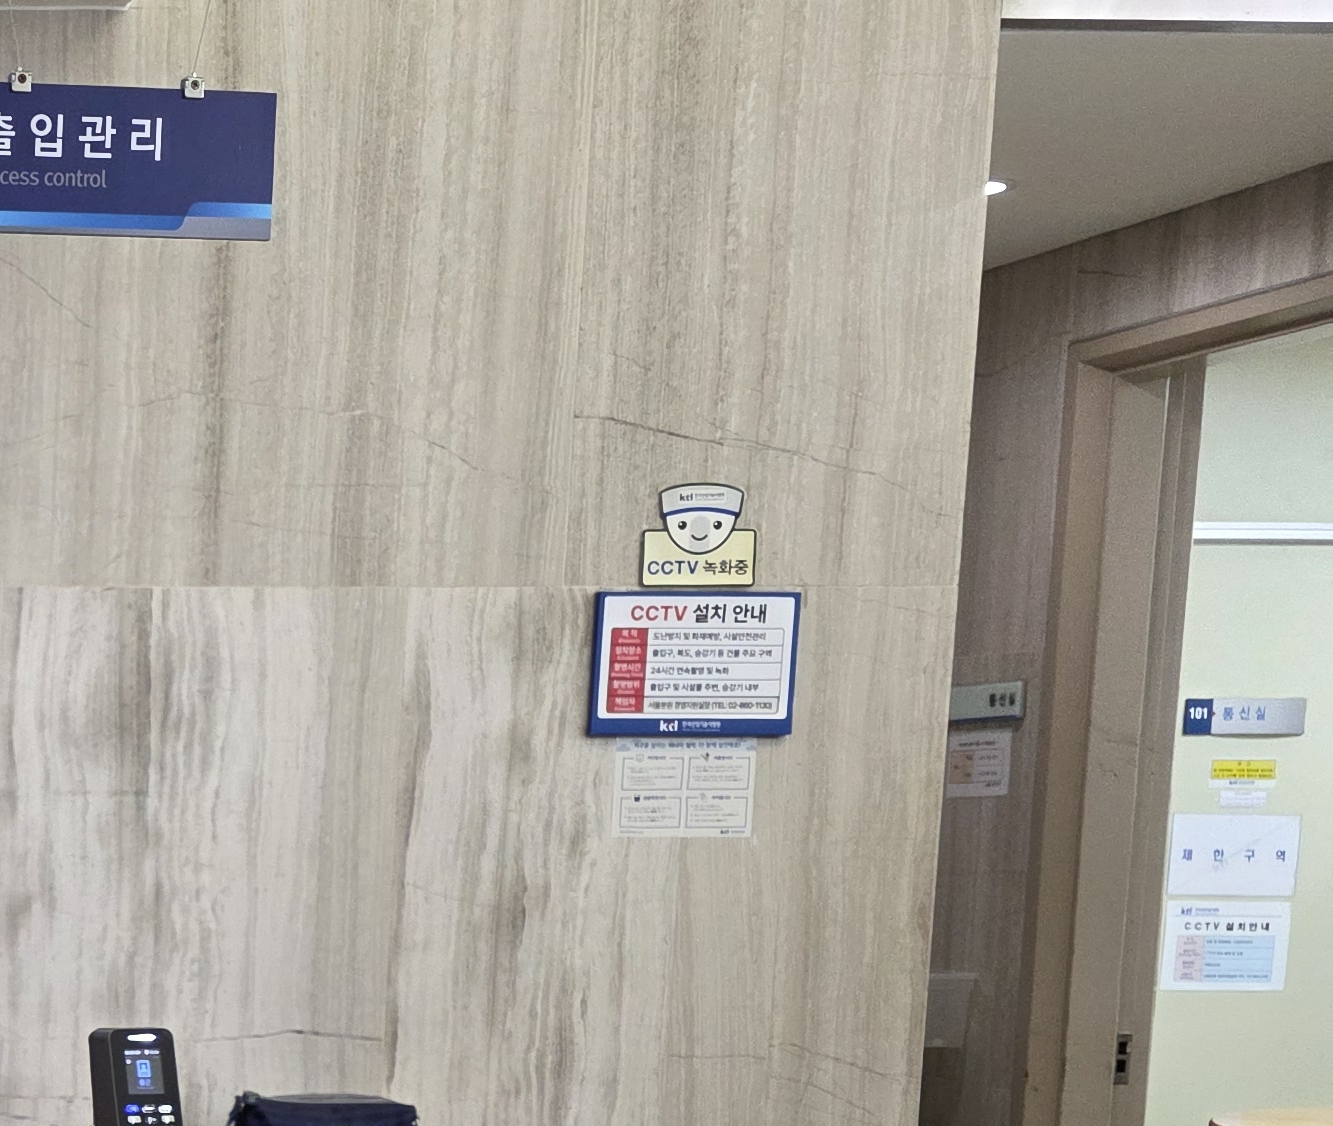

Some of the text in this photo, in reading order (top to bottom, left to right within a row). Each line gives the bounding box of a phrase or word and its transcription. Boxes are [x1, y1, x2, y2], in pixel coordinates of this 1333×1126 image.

[43, 169, 108, 189] control
[647, 558, 750, 577] CCTV 녹화중
[630, 603, 767, 624] CCTV 설치 안내
[1189, 706, 1208, 720] 101
[1184, 921, 1220, 931] CCTV
